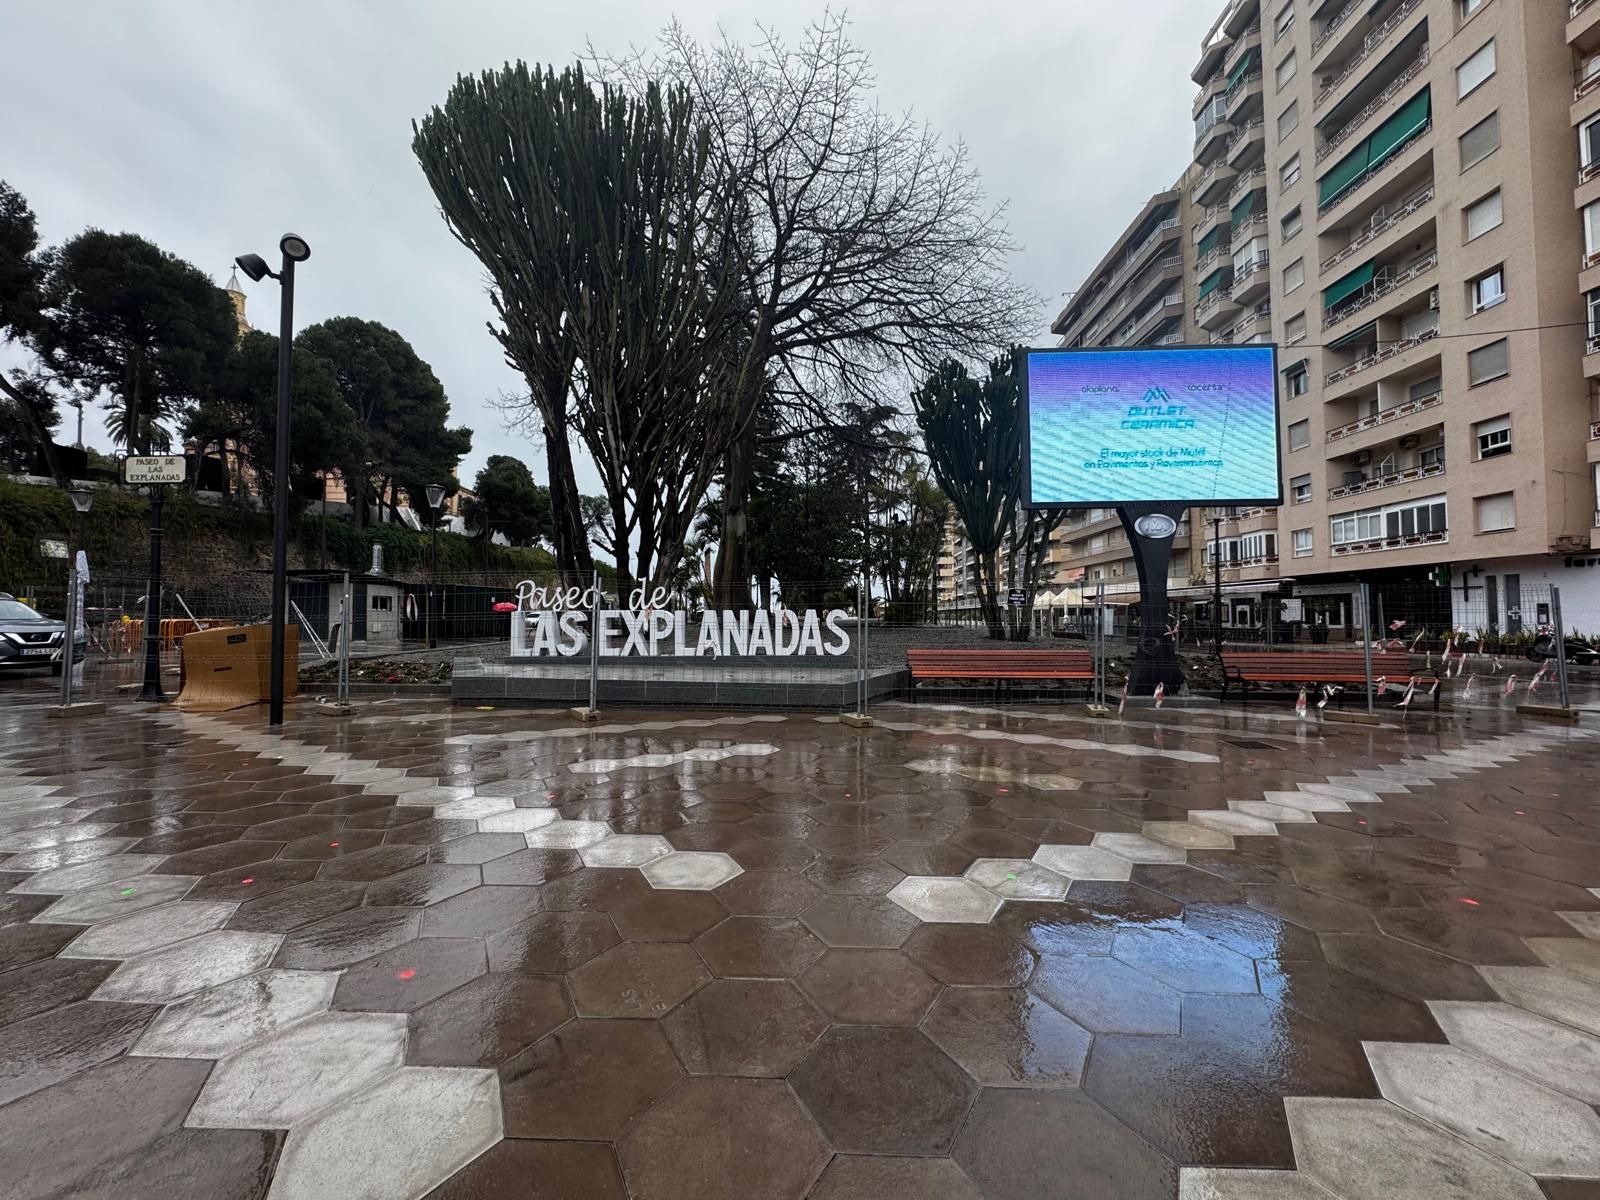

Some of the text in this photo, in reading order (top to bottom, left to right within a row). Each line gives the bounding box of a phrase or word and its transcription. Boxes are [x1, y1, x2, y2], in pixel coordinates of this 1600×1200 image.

[1128, 405, 1187, 416] OUTLET
[1100, 448, 1109, 458] El
[1111, 449, 1138, 460] mayor
[1140, 447, 1164, 458] stock
[1165, 447, 1178, 457] de
[1084, 461, 1096, 469] en
[1097, 459, 1148, 469] Pavimentos
[515, 577, 675, 612] Paseo de
[511, 609, 851, 657] LAS EXPLANADAS
